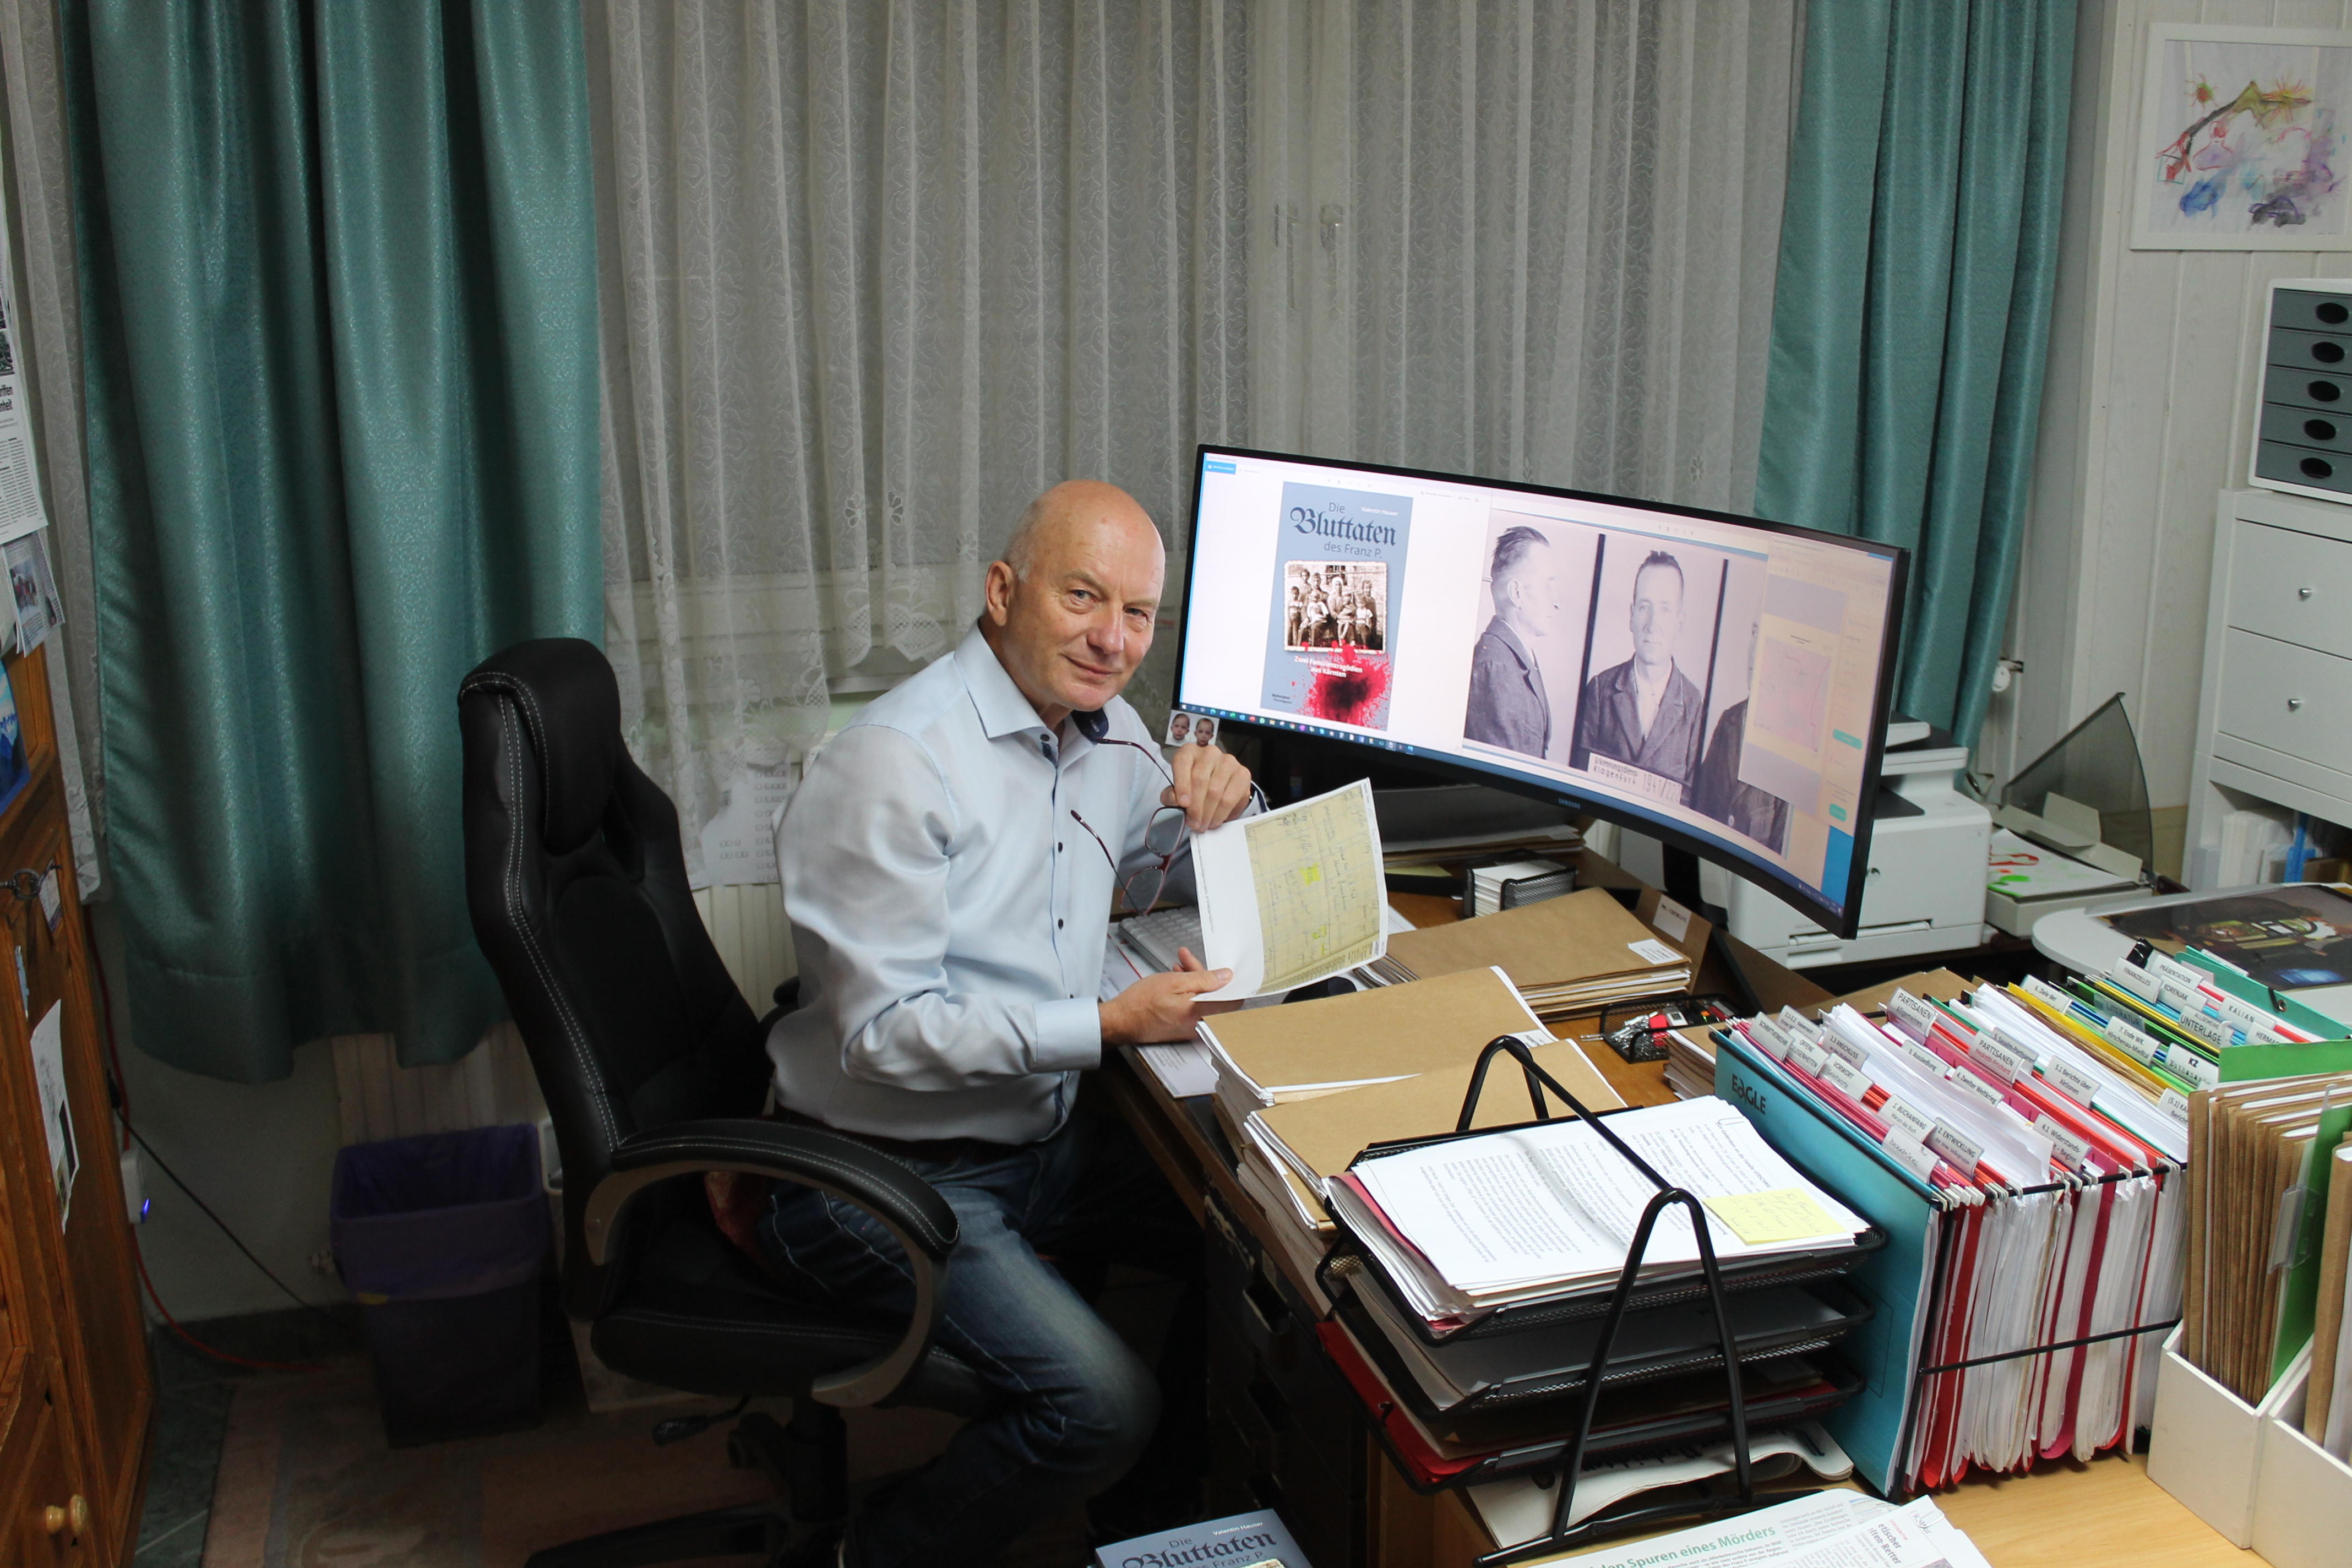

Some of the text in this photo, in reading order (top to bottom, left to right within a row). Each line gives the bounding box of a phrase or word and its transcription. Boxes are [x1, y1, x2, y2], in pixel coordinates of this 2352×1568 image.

[1329, 502, 1345, 513] Die
[1290, 507, 1396, 546] Bluttaten
[1324, 541, 1382, 558] des Franz P.
[1294, 656, 1363, 673] Zwei Familientragödien
[1322, 667, 1347, 678] Kärnten
[1593, 765, 1636, 785] Klagenfurt
[2124, 967, 2152, 987] FINANZIELLES
[2159, 963, 2191, 984] PRÄSENTATION
[2038, 987, 2050, 999] Ziele
[2048, 993, 2057, 1001] der
[2164, 983, 2188, 1001] KORENJAK
[1896, 1005, 1923, 1027] Allgemeines
[1897, 993, 1933, 1020] PARTISANEN
[2106, 1003, 2141, 1027] LITERATUR
[2228, 1004, 2255, 1023] KALIAN
[2180, 1016, 2222, 1045] UNTERLAGE
[2195, 1012, 2220, 1030] ALLGEMEINE
[1759, 1020, 1788, 1047] SCHRIFTVERKEHR
[2123, 1027, 2136, 1041] Ende
[1799, 1039, 1815, 1053] OFFENE
[1837, 1039, 1859, 1059] ANSCHLUSS
[1979, 1039, 2014, 1067] PARTISANEN
[1833, 1060, 1854, 1080] VORWORT
[2188, 1057, 2199, 1068] KZ
[1826, 1069, 1848, 1088] Geleitworte
[2059, 1079, 2079, 1095] Aktionen
[2061, 1068, 2081, 1085] Berichte
[2080, 1079, 2092, 1091] über
[1960, 1074, 1977, 1089] Zweiter
[1976, 1085, 1997, 1105] Weltkrieg
[1897, 1106, 1927, 1130] BUCHANFANG
[1908, 1124, 1917, 1134] Buch
[2041, 1124, 2050, 1133] 4.1
[2051, 1129, 2081, 1153] Widerstands-
[1942, 1130, 1975, 1158] ENTWICKLUNG
[1213, 1521, 1264, 1536] Valentin Hauser
[1878, 1523, 1902, 1549] etischer
[1122, 1533, 1277, 1568] Bluttaten
[1168, 1537, 1193, 1549] Die
[1627, 1551, 1678, 1568] Spuren
[1680, 1542, 1717, 1556] eines
[1717, 1526, 1776, 1548] Mörders
[1212, 1551, 1267, 1568] Franz P.
